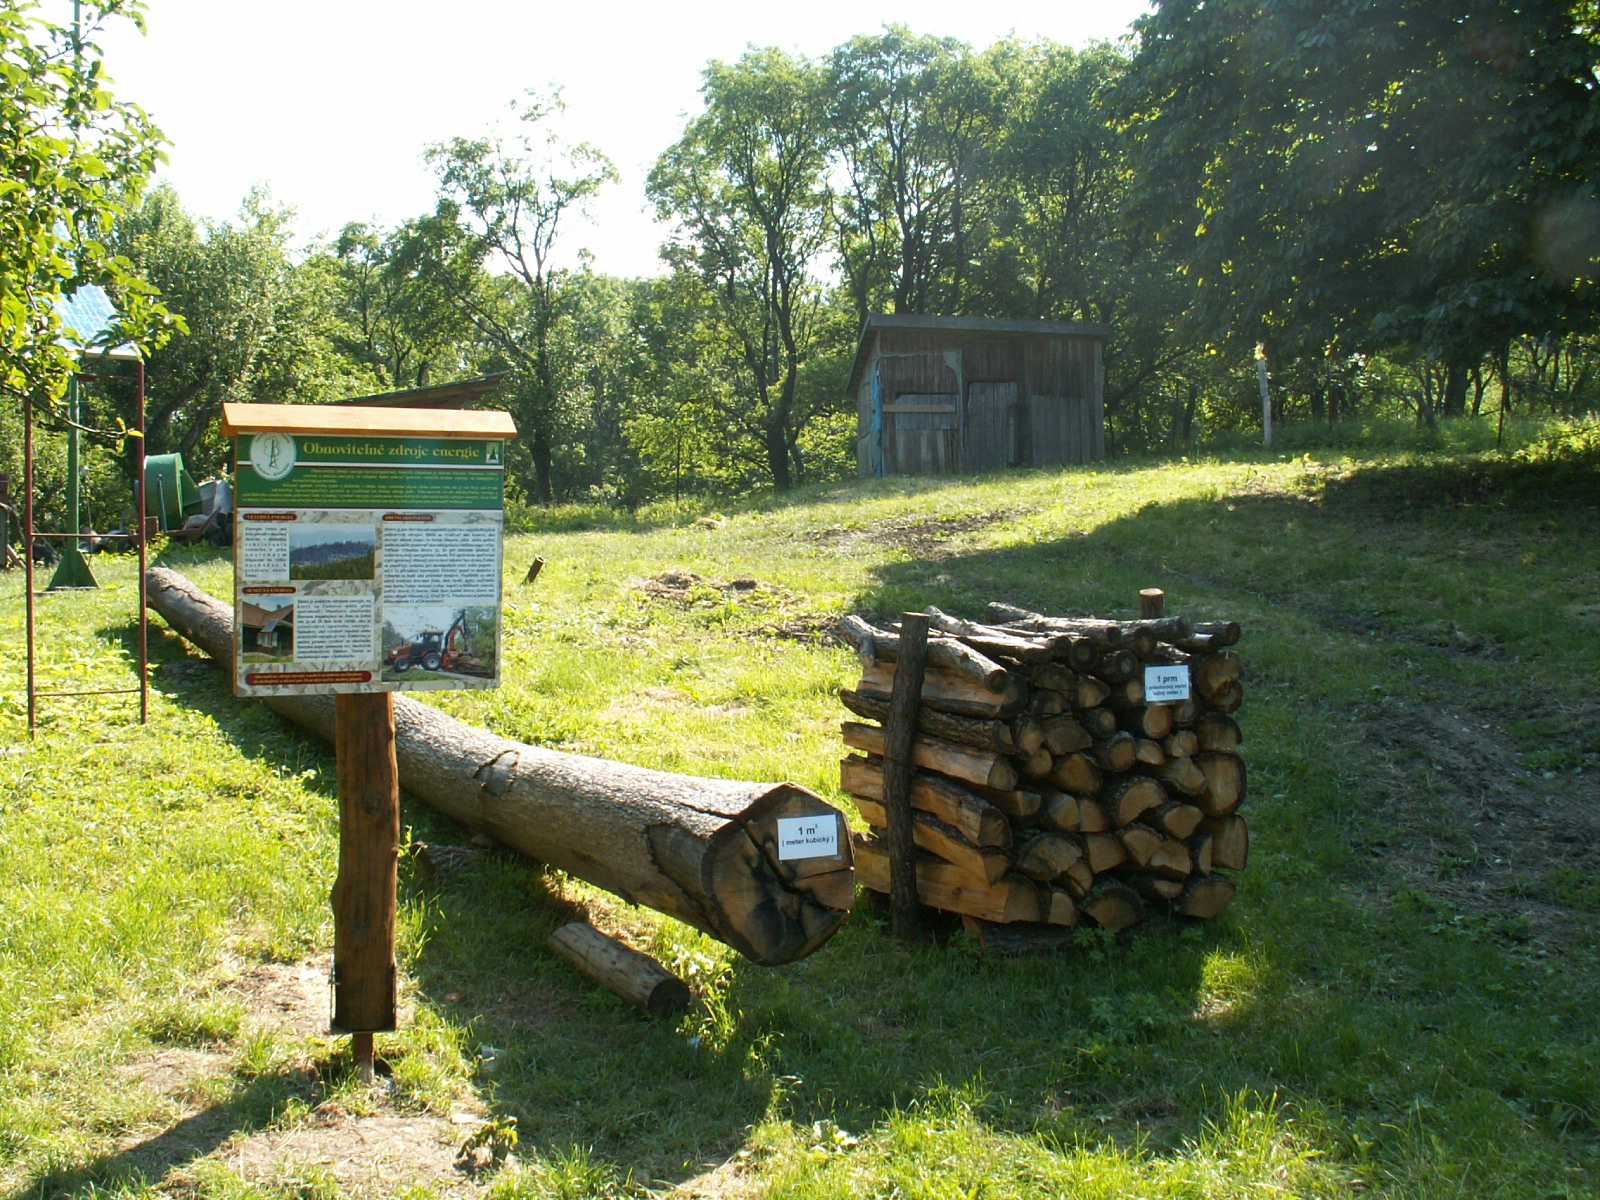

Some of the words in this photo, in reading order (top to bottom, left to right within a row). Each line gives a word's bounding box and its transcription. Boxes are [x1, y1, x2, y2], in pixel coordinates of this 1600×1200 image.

[303, 441, 385, 456] Obnoviteľné
[388, 444, 429, 459] zdroje
[432, 446, 480, 459] energie
[1163, 675, 1178, 684] prm
[798, 826, 803, 835] 1
[806, 836, 830, 844] kubický
